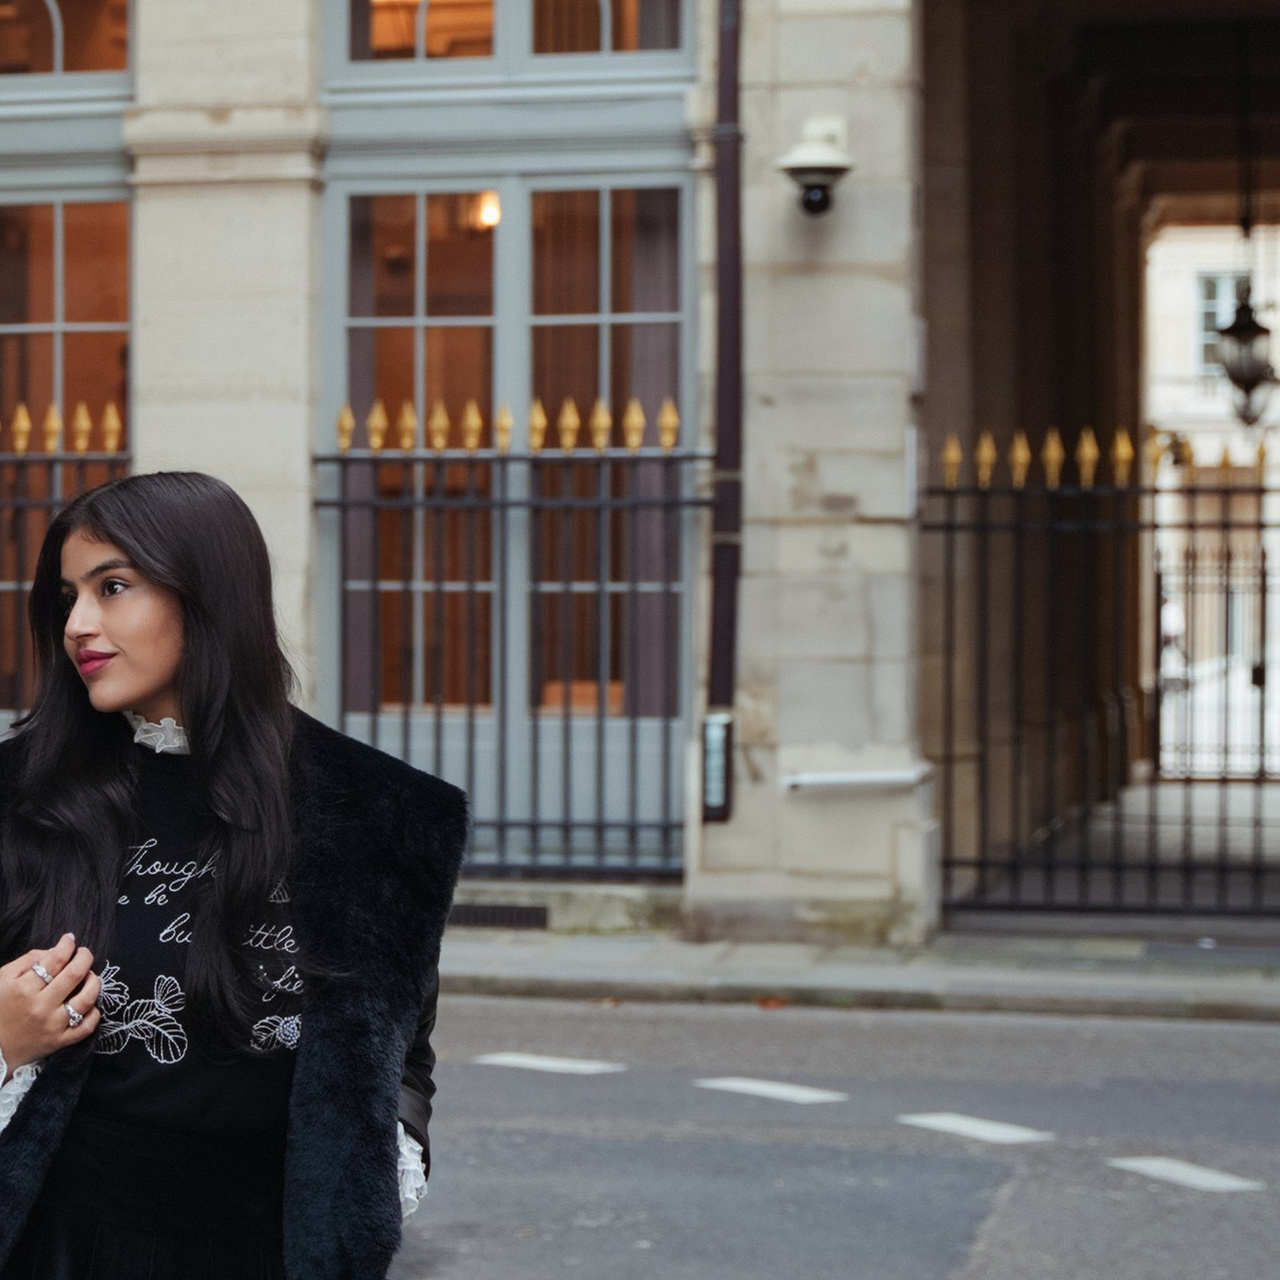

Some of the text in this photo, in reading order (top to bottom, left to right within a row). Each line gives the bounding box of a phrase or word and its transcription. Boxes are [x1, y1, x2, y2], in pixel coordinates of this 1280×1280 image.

[124, 838, 221, 892] Though
[144, 883, 168, 906] be
[159, 912, 300, 953] bu ttle
[262, 965, 305, 1002] fie
